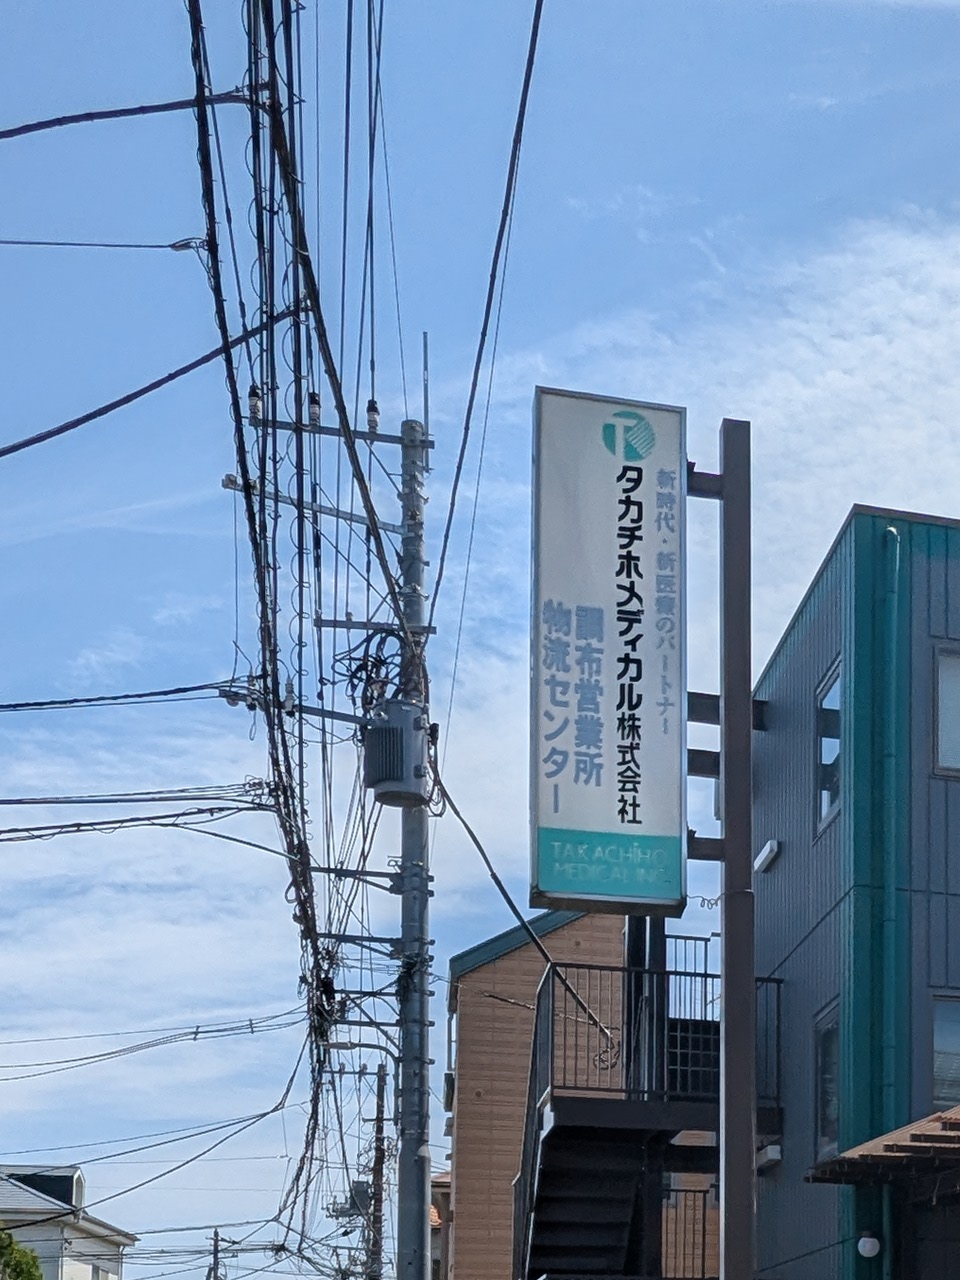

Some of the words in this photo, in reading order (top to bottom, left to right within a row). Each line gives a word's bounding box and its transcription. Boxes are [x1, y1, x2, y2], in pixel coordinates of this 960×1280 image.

[542, 598, 571, 813] 物流センター
[573, 605, 604, 787] 調布営業所
[615, 465, 643, 824] タカチホメディカル株式会社
